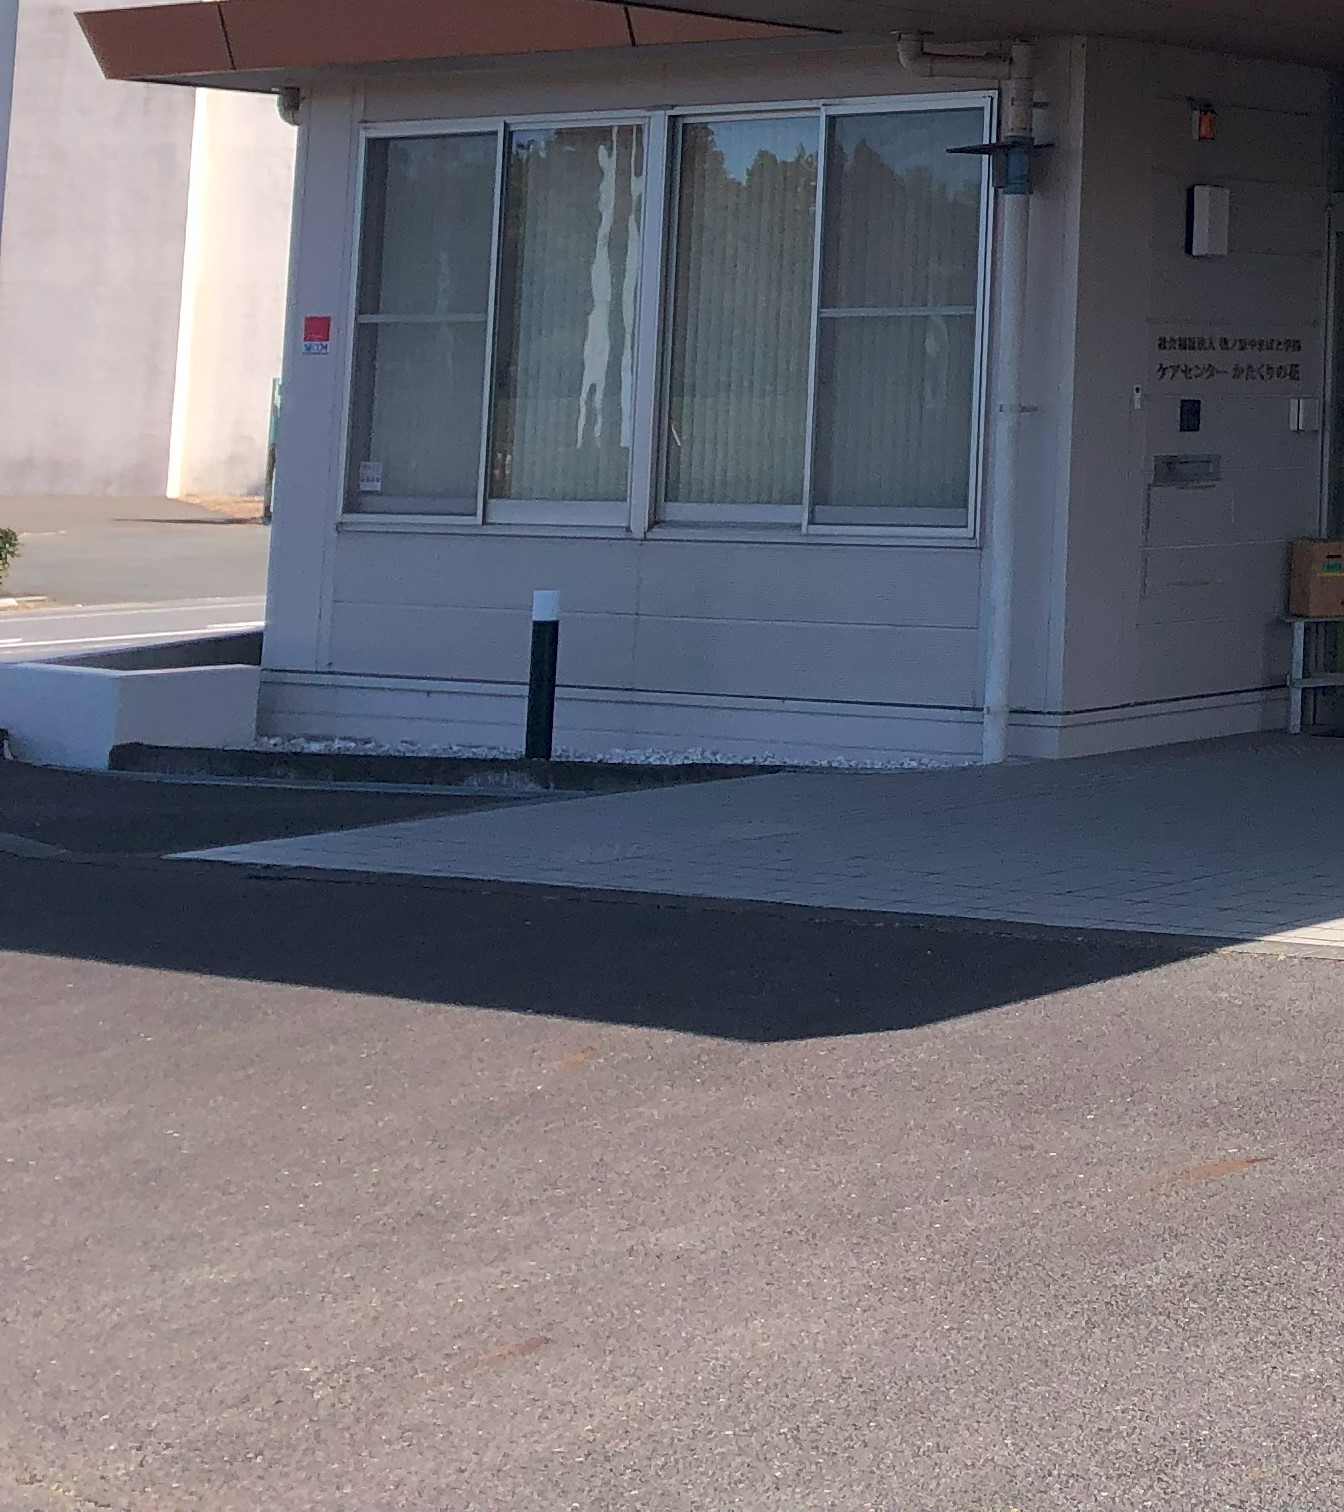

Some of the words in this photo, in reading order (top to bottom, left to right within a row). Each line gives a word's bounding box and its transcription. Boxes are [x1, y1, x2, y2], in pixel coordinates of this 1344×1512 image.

[1156, 362, 1229, 381] ケアセンター
